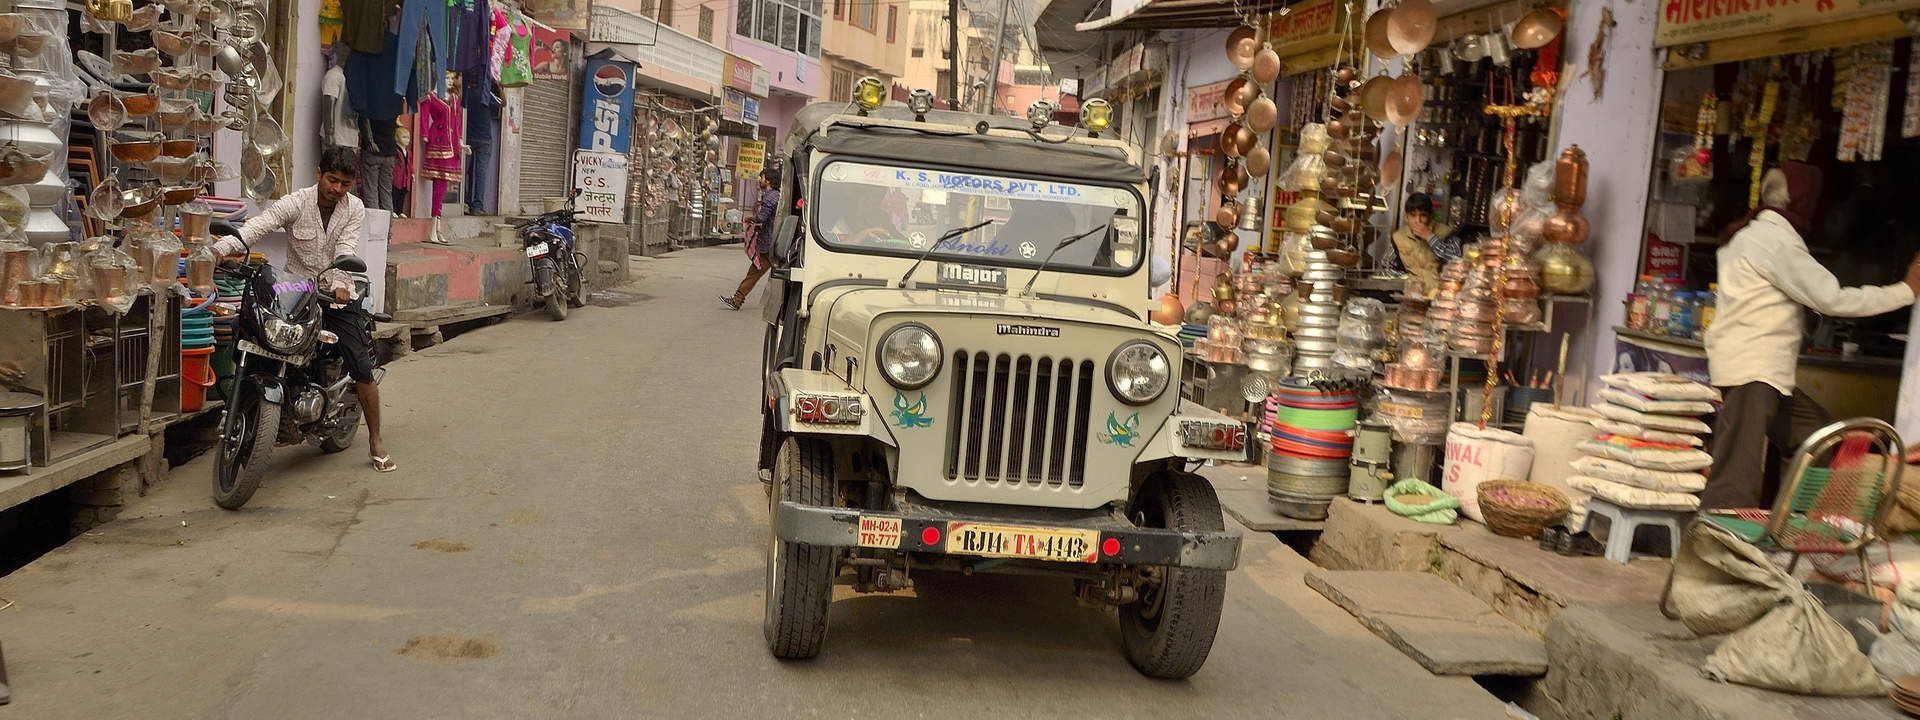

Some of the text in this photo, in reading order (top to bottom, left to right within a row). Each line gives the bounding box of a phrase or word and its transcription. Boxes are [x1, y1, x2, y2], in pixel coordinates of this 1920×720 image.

[580, 155, 603, 167] VICKY
[895, 170, 911, 181] K.
[918, 172, 931, 182] S.
[938, 174, 1002, 191] MOTORS
[1008, 181, 1042, 193] PVT.
[1049, 185, 1081, 197] LTD.
[998, 324, 1060, 337] Mahindra
[861, 520, 899, 533] MH-02-A
[860, 532, 898, 546] TR-777
[963, 530, 1085, 559] RJ14 TA 4443
